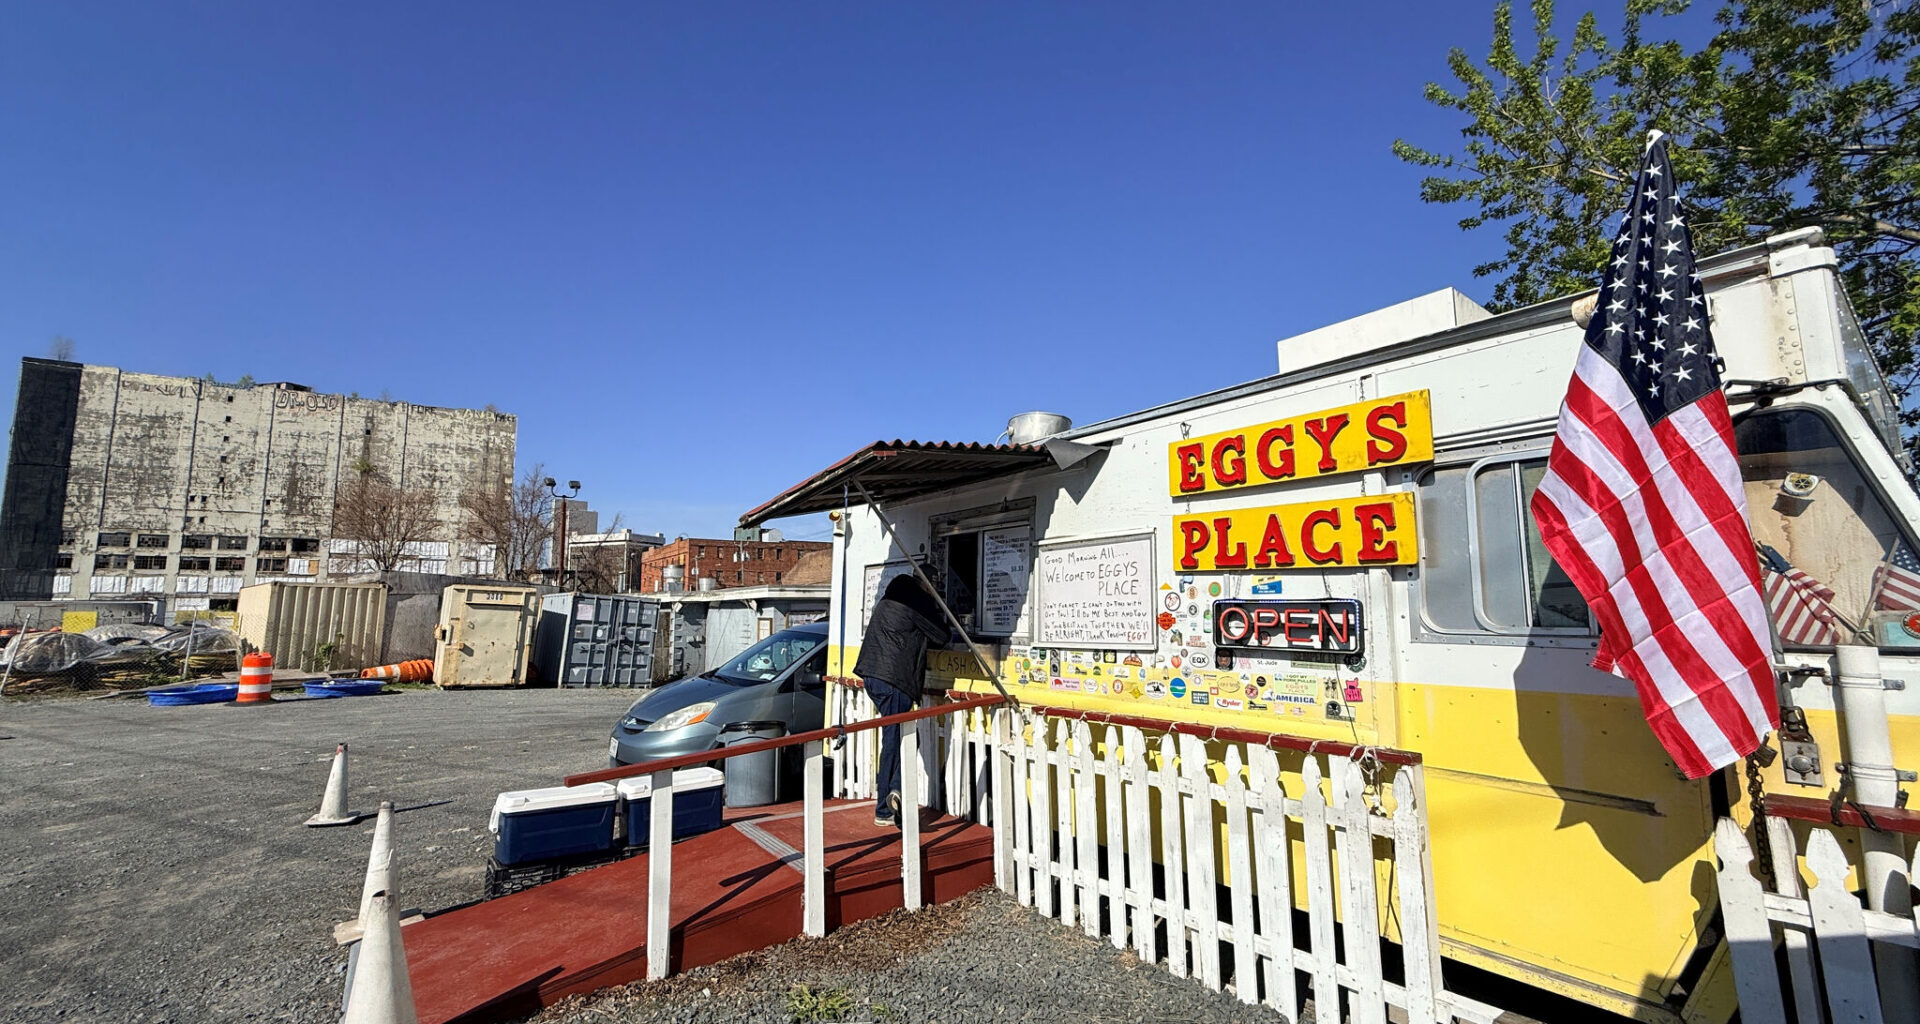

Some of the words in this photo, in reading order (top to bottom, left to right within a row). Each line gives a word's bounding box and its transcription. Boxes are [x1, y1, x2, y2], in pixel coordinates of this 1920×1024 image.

[1177, 401, 1408, 493] EGGYS
[1180, 502, 1398, 569] PLACE
[1098, 561, 1139, 580] EGGYS
[1098, 580, 1139, 596] PLACE
[1127, 631, 1148, 642] EGGY
[1220, 606, 1349, 645] OPEN
[936, 650, 967, 675] CASH
[1222, 699, 1241, 708] Ryder
